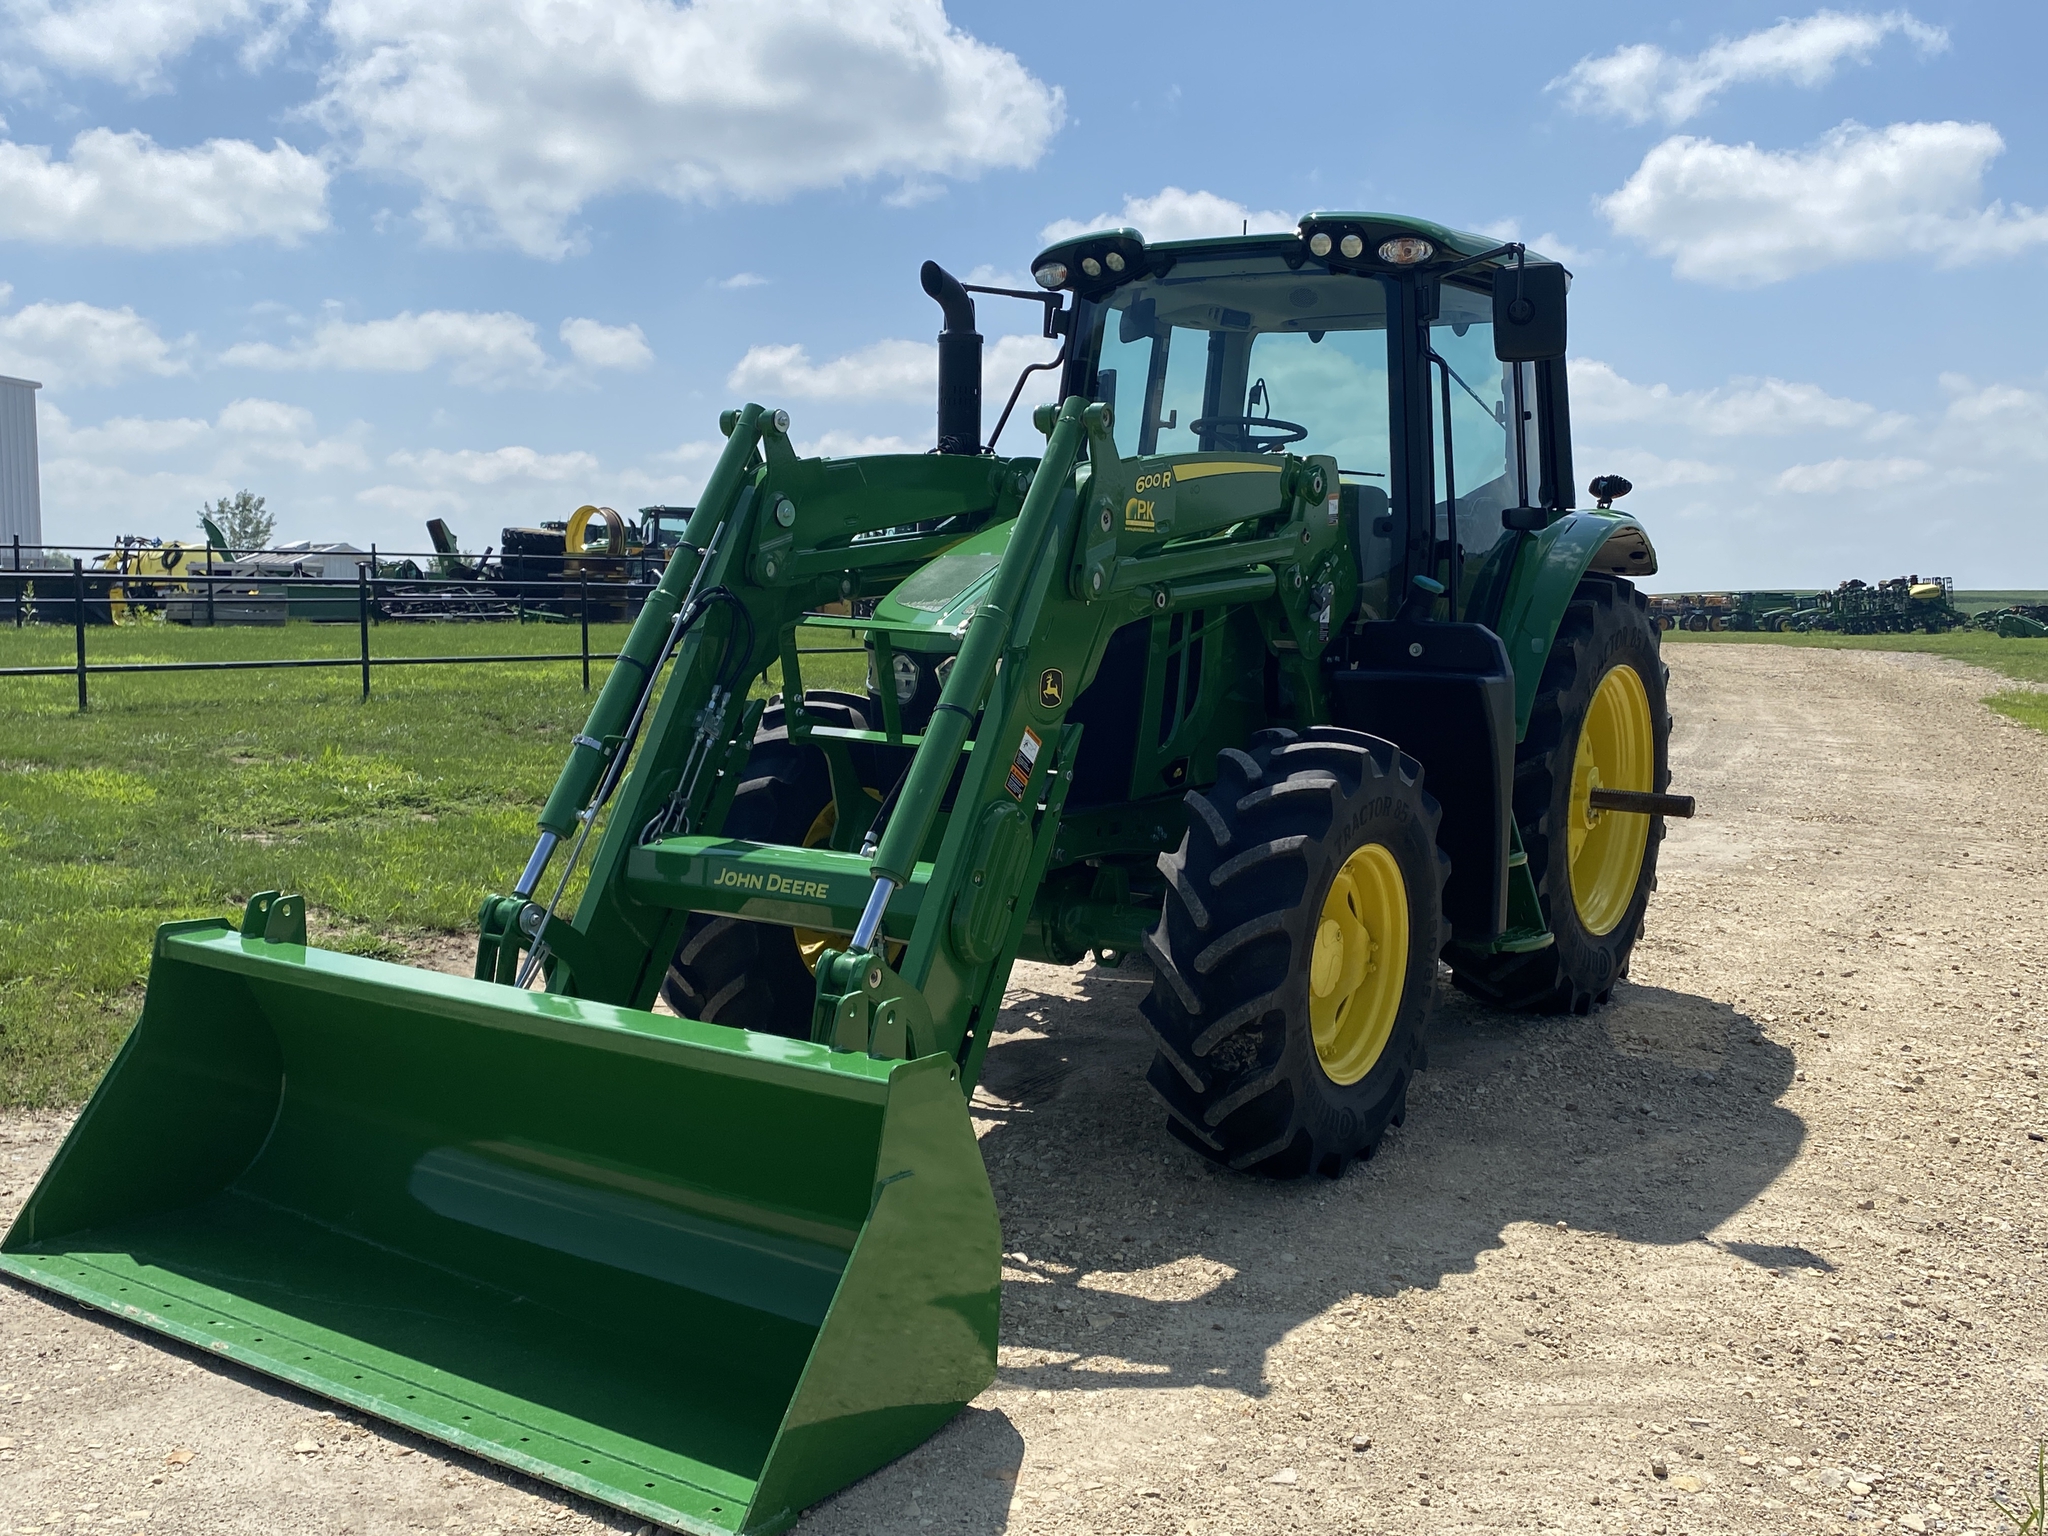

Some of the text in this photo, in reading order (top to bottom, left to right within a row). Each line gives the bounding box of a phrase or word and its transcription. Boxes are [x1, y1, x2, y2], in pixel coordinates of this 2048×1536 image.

[1333, 796, 1410, 855] TRACTOR 85
[713, 867, 830, 899] JOHN DEERE
